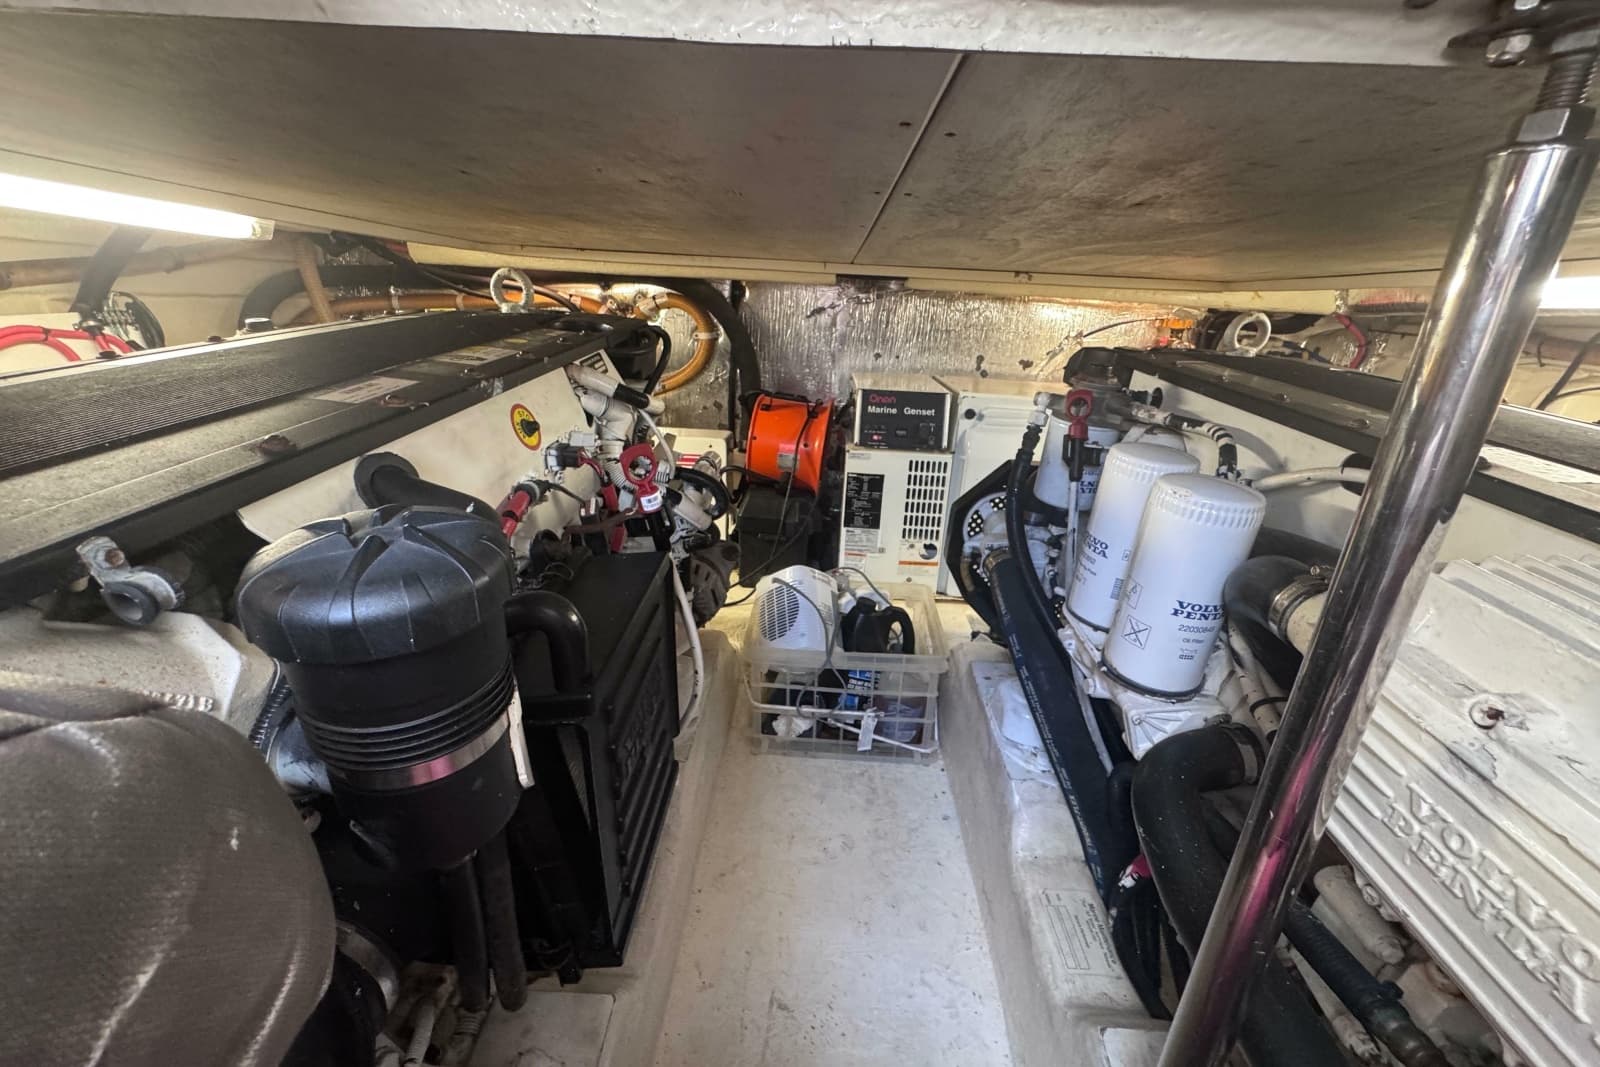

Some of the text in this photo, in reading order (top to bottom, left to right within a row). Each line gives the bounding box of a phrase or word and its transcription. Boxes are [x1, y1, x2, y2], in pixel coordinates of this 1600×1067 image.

[867, 405, 935, 416] Marine Genset
[1381, 802, 1592, 1025] PENTA
[1407, 782, 1600, 984] VOLVO
